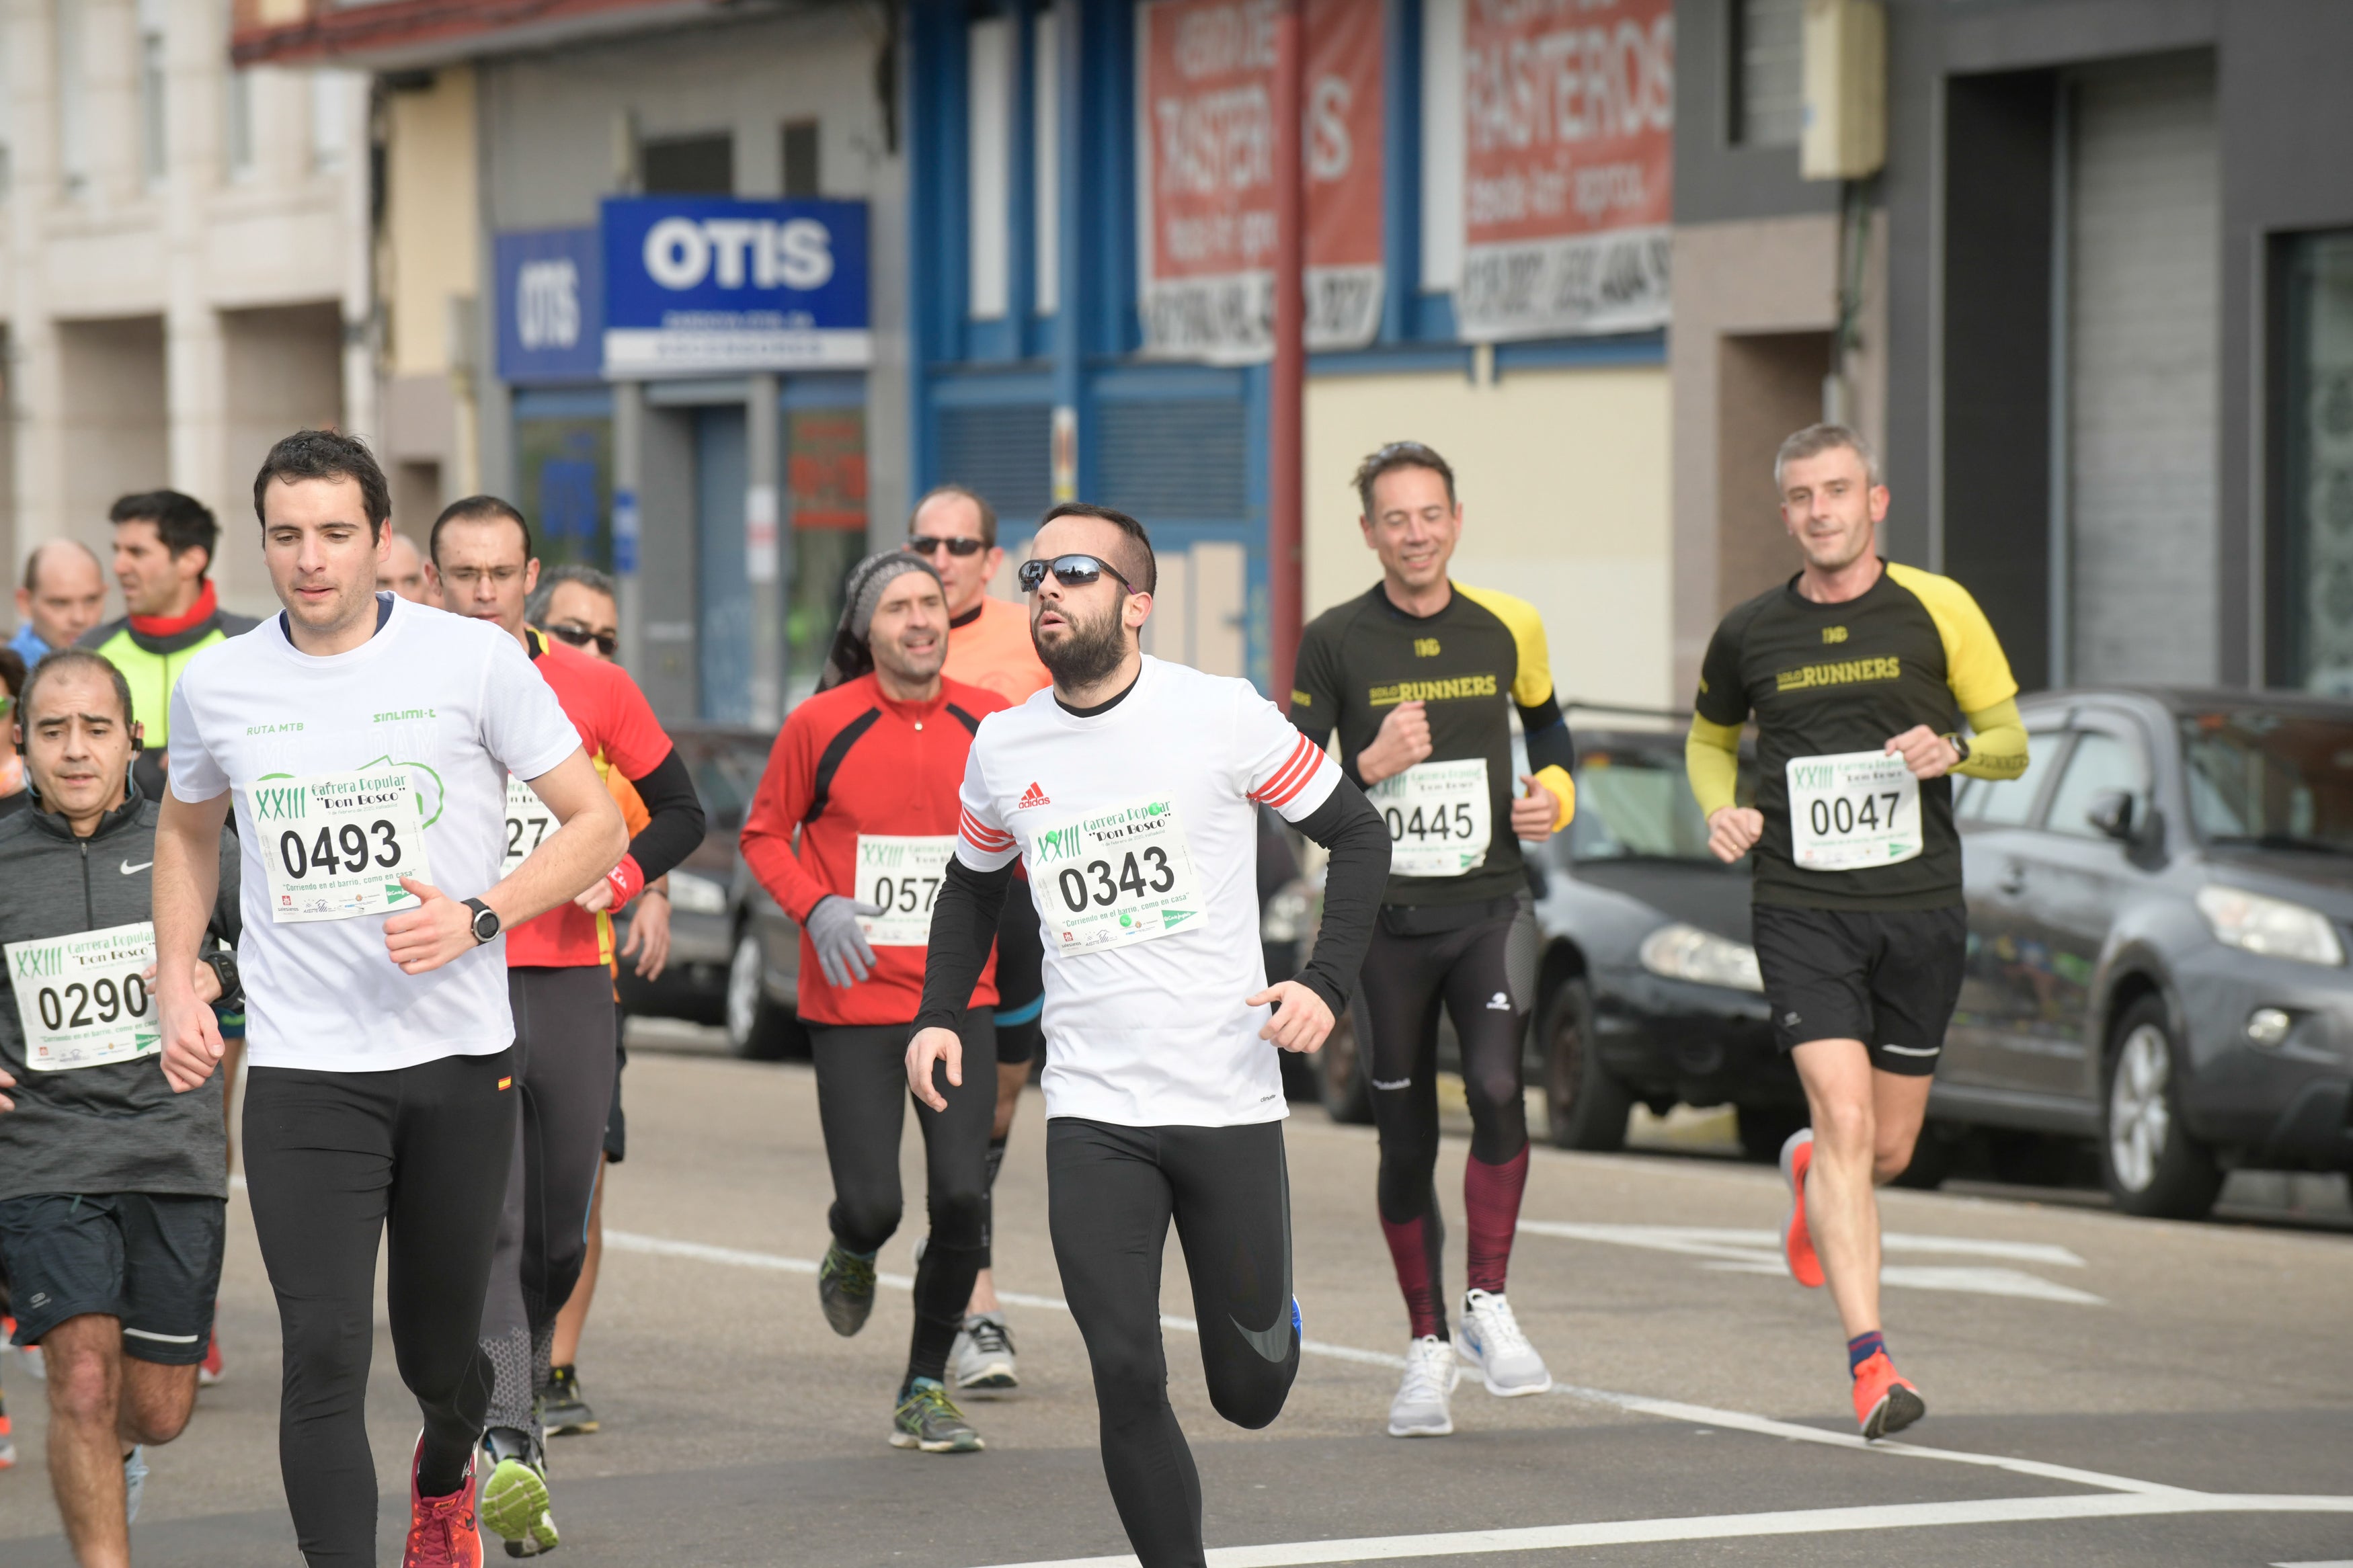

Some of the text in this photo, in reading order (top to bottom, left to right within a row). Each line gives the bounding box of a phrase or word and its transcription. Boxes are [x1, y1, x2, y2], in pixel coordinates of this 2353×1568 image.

[643, 216, 834, 291] OTIS
[516, 257, 580, 349] OTIS
[1398, 675, 1497, 700] RUNNERS
[1802, 657, 1901, 687] RUNNERS
[247, 723, 304, 735] RUTA MTB
[312, 775, 406, 796] Carrera Popular
[1794, 764, 1833, 790] XXIII
[256, 786, 306, 823] XXIII
[1019, 797, 1050, 809] adidas
[1083, 800, 1170, 832] Carrera Popar
[1811, 792, 1900, 835] 0047
[506, 817, 548, 856] 27
[1386, 803, 1472, 841] 0445
[280, 819, 401, 879] 0493
[863, 842, 904, 868] XXIII
[363, 876, 383, 884] como
[875, 877, 940, 912] 057
[1058, 846, 1174, 913] 0343
[1110, 909, 1116, 917] el
[1141, 902, 1159, 910] como
[15, 946, 63, 980] XXIII
[68, 940, 110, 954] Carrera
[39, 973, 149, 1030] 0290
